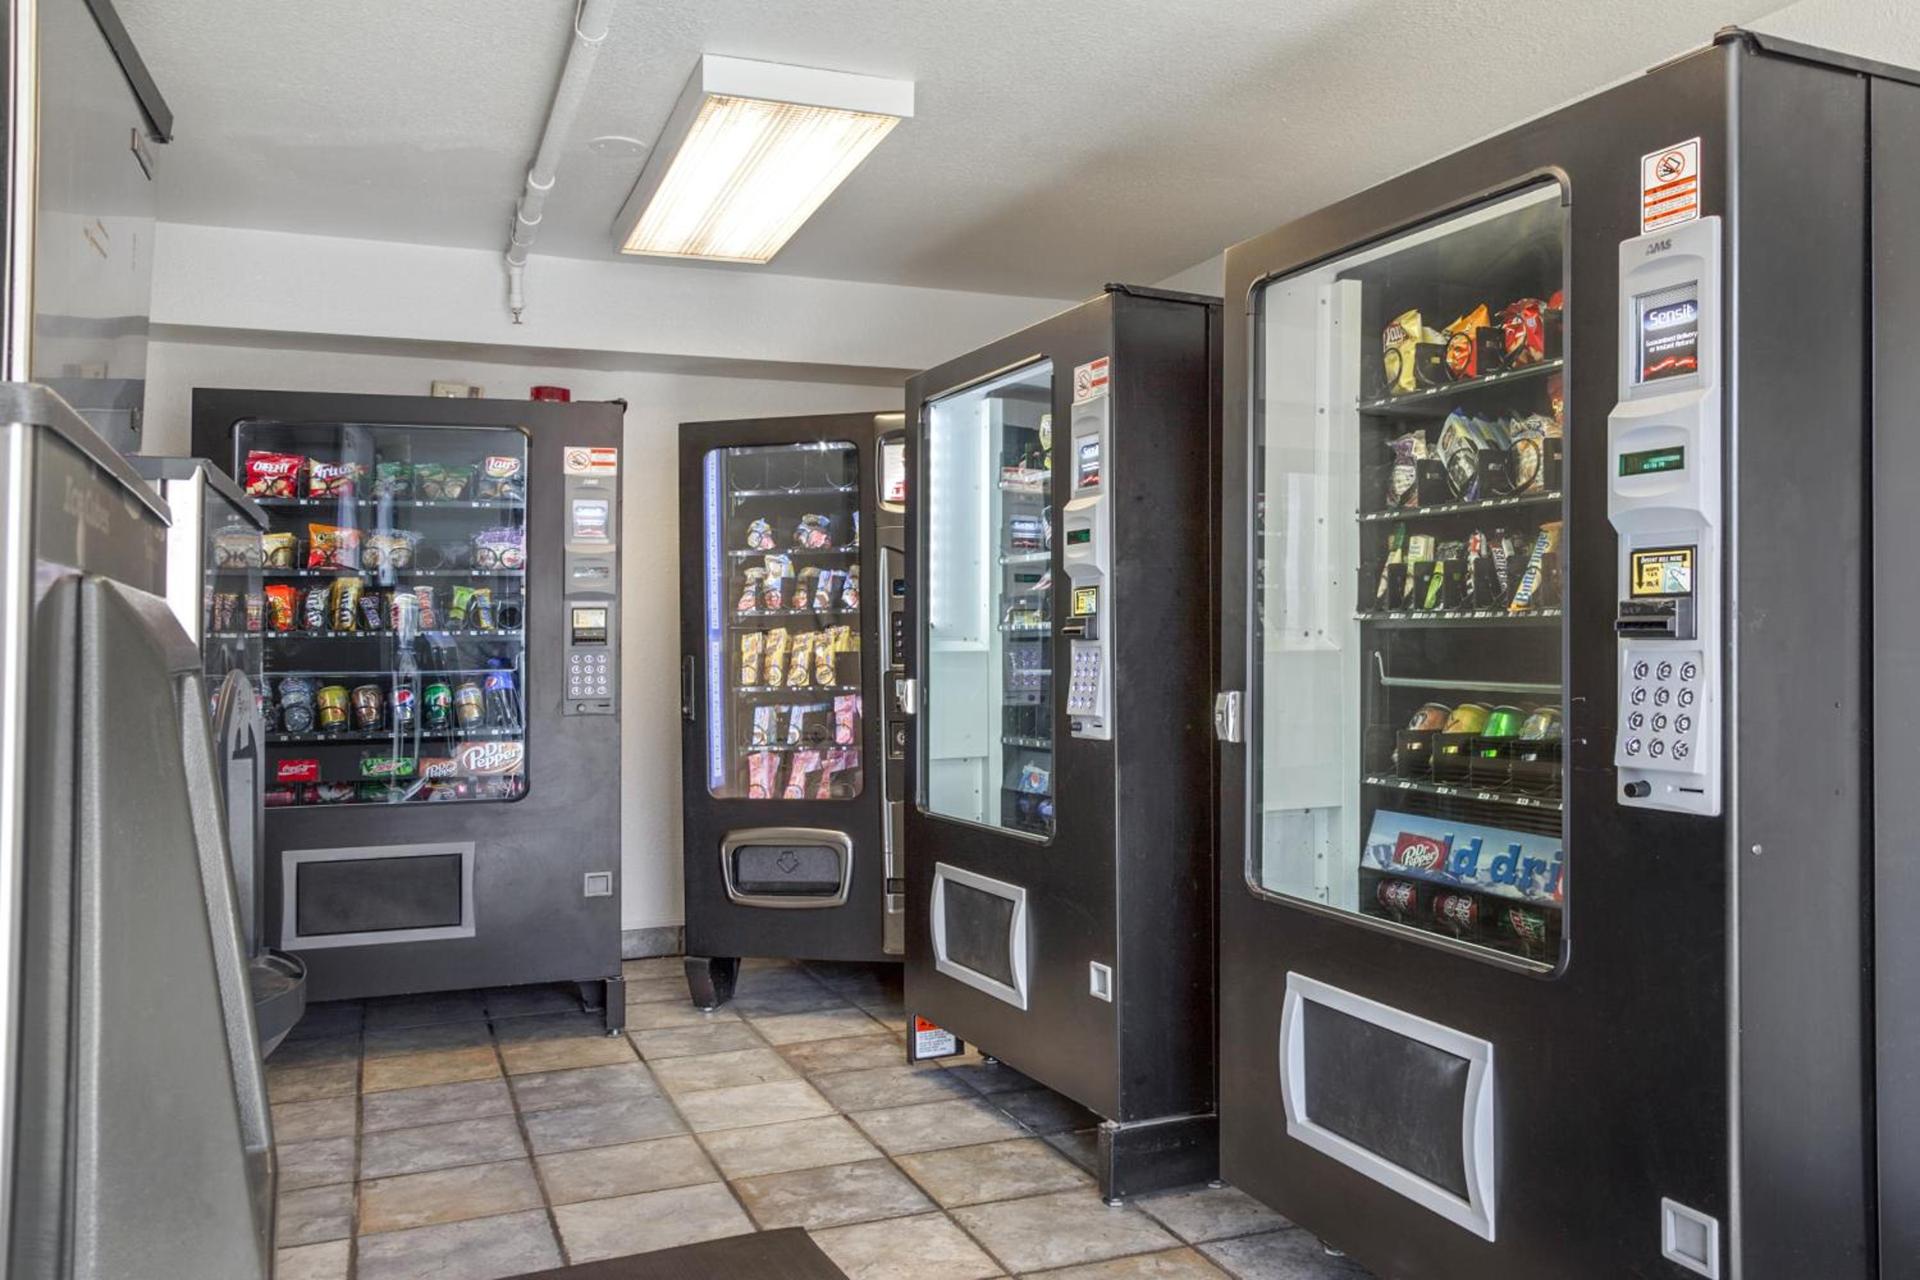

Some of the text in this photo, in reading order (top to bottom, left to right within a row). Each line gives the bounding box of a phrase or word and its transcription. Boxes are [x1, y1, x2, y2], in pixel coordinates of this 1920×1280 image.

[1645, 239, 1671, 256] AMS
[470, 748, 519, 770] Pepper
[1404, 848, 1438, 867] Pepper
